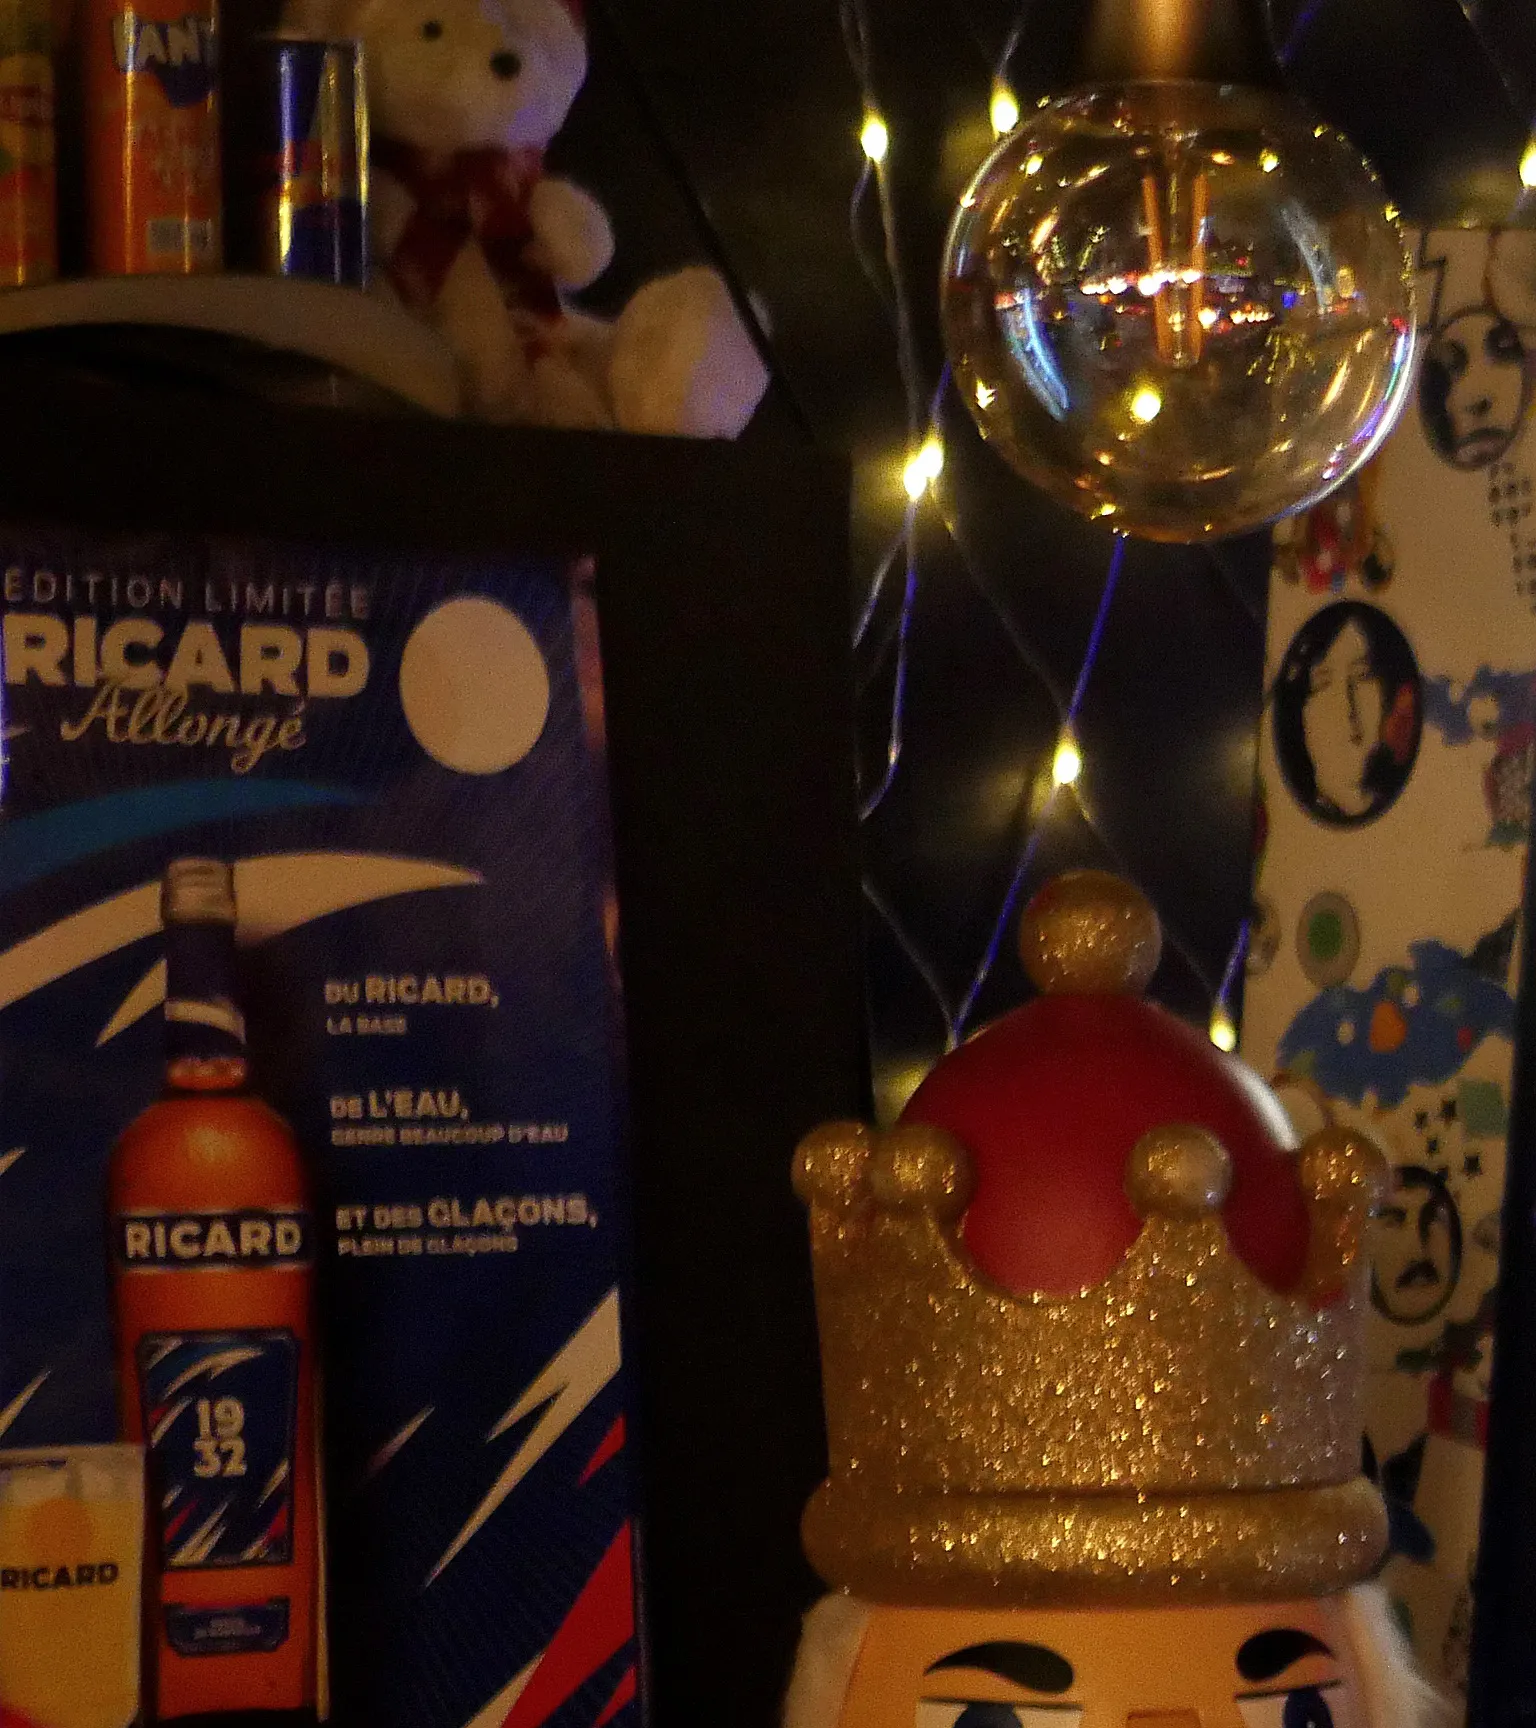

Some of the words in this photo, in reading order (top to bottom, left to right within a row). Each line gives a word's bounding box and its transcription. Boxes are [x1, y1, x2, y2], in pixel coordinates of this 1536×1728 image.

[2, 612, 370, 698] RICARD
[60, 681, 307, 774] Allongé
[365, 975, 499, 1008] RICARD,
[368, 1088, 469, 1121] L'EAU,
[124, 1218, 302, 1260] RICARD
[0, 1562, 119, 1590] RICARD
